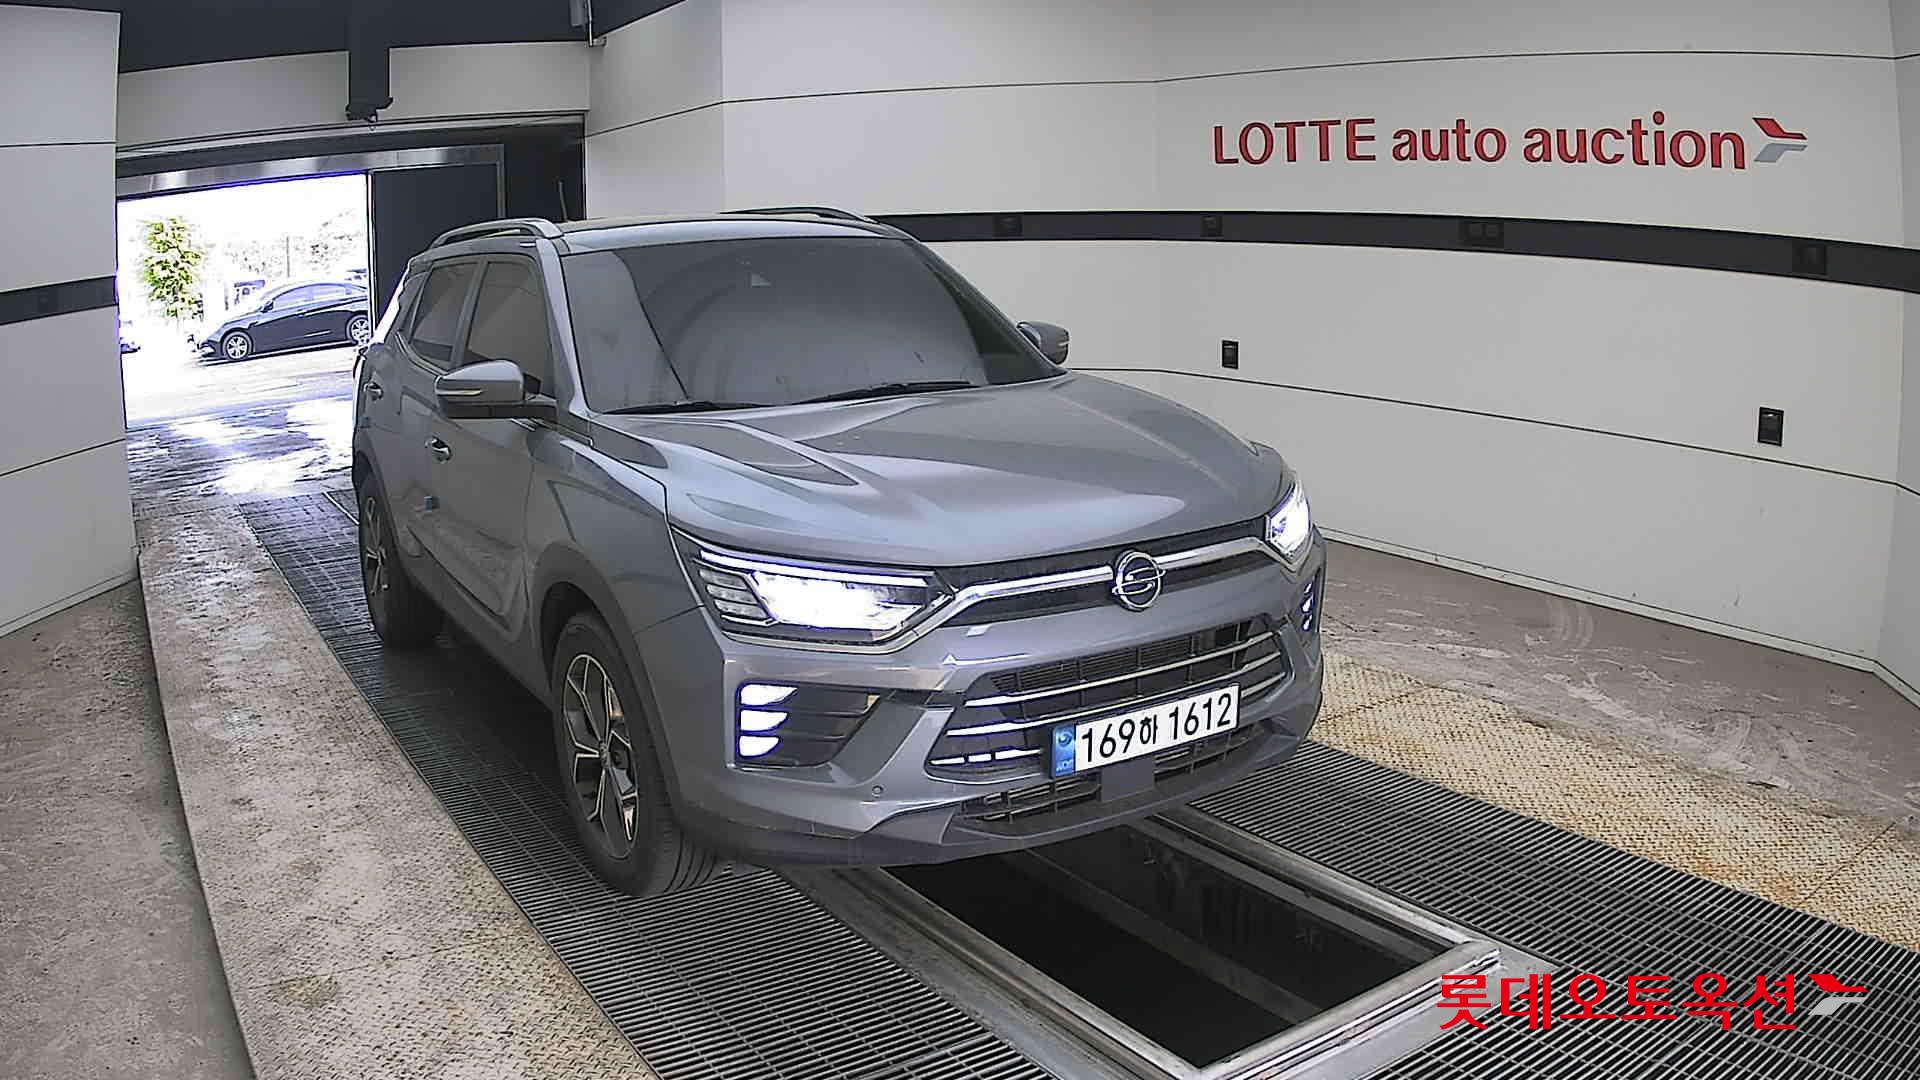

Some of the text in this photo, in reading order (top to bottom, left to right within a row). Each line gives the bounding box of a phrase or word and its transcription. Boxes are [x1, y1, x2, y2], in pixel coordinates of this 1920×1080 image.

[1213, 111, 1746, 170] LOTTE auto auction
[1081, 693, 1232, 763] 169하 1612
